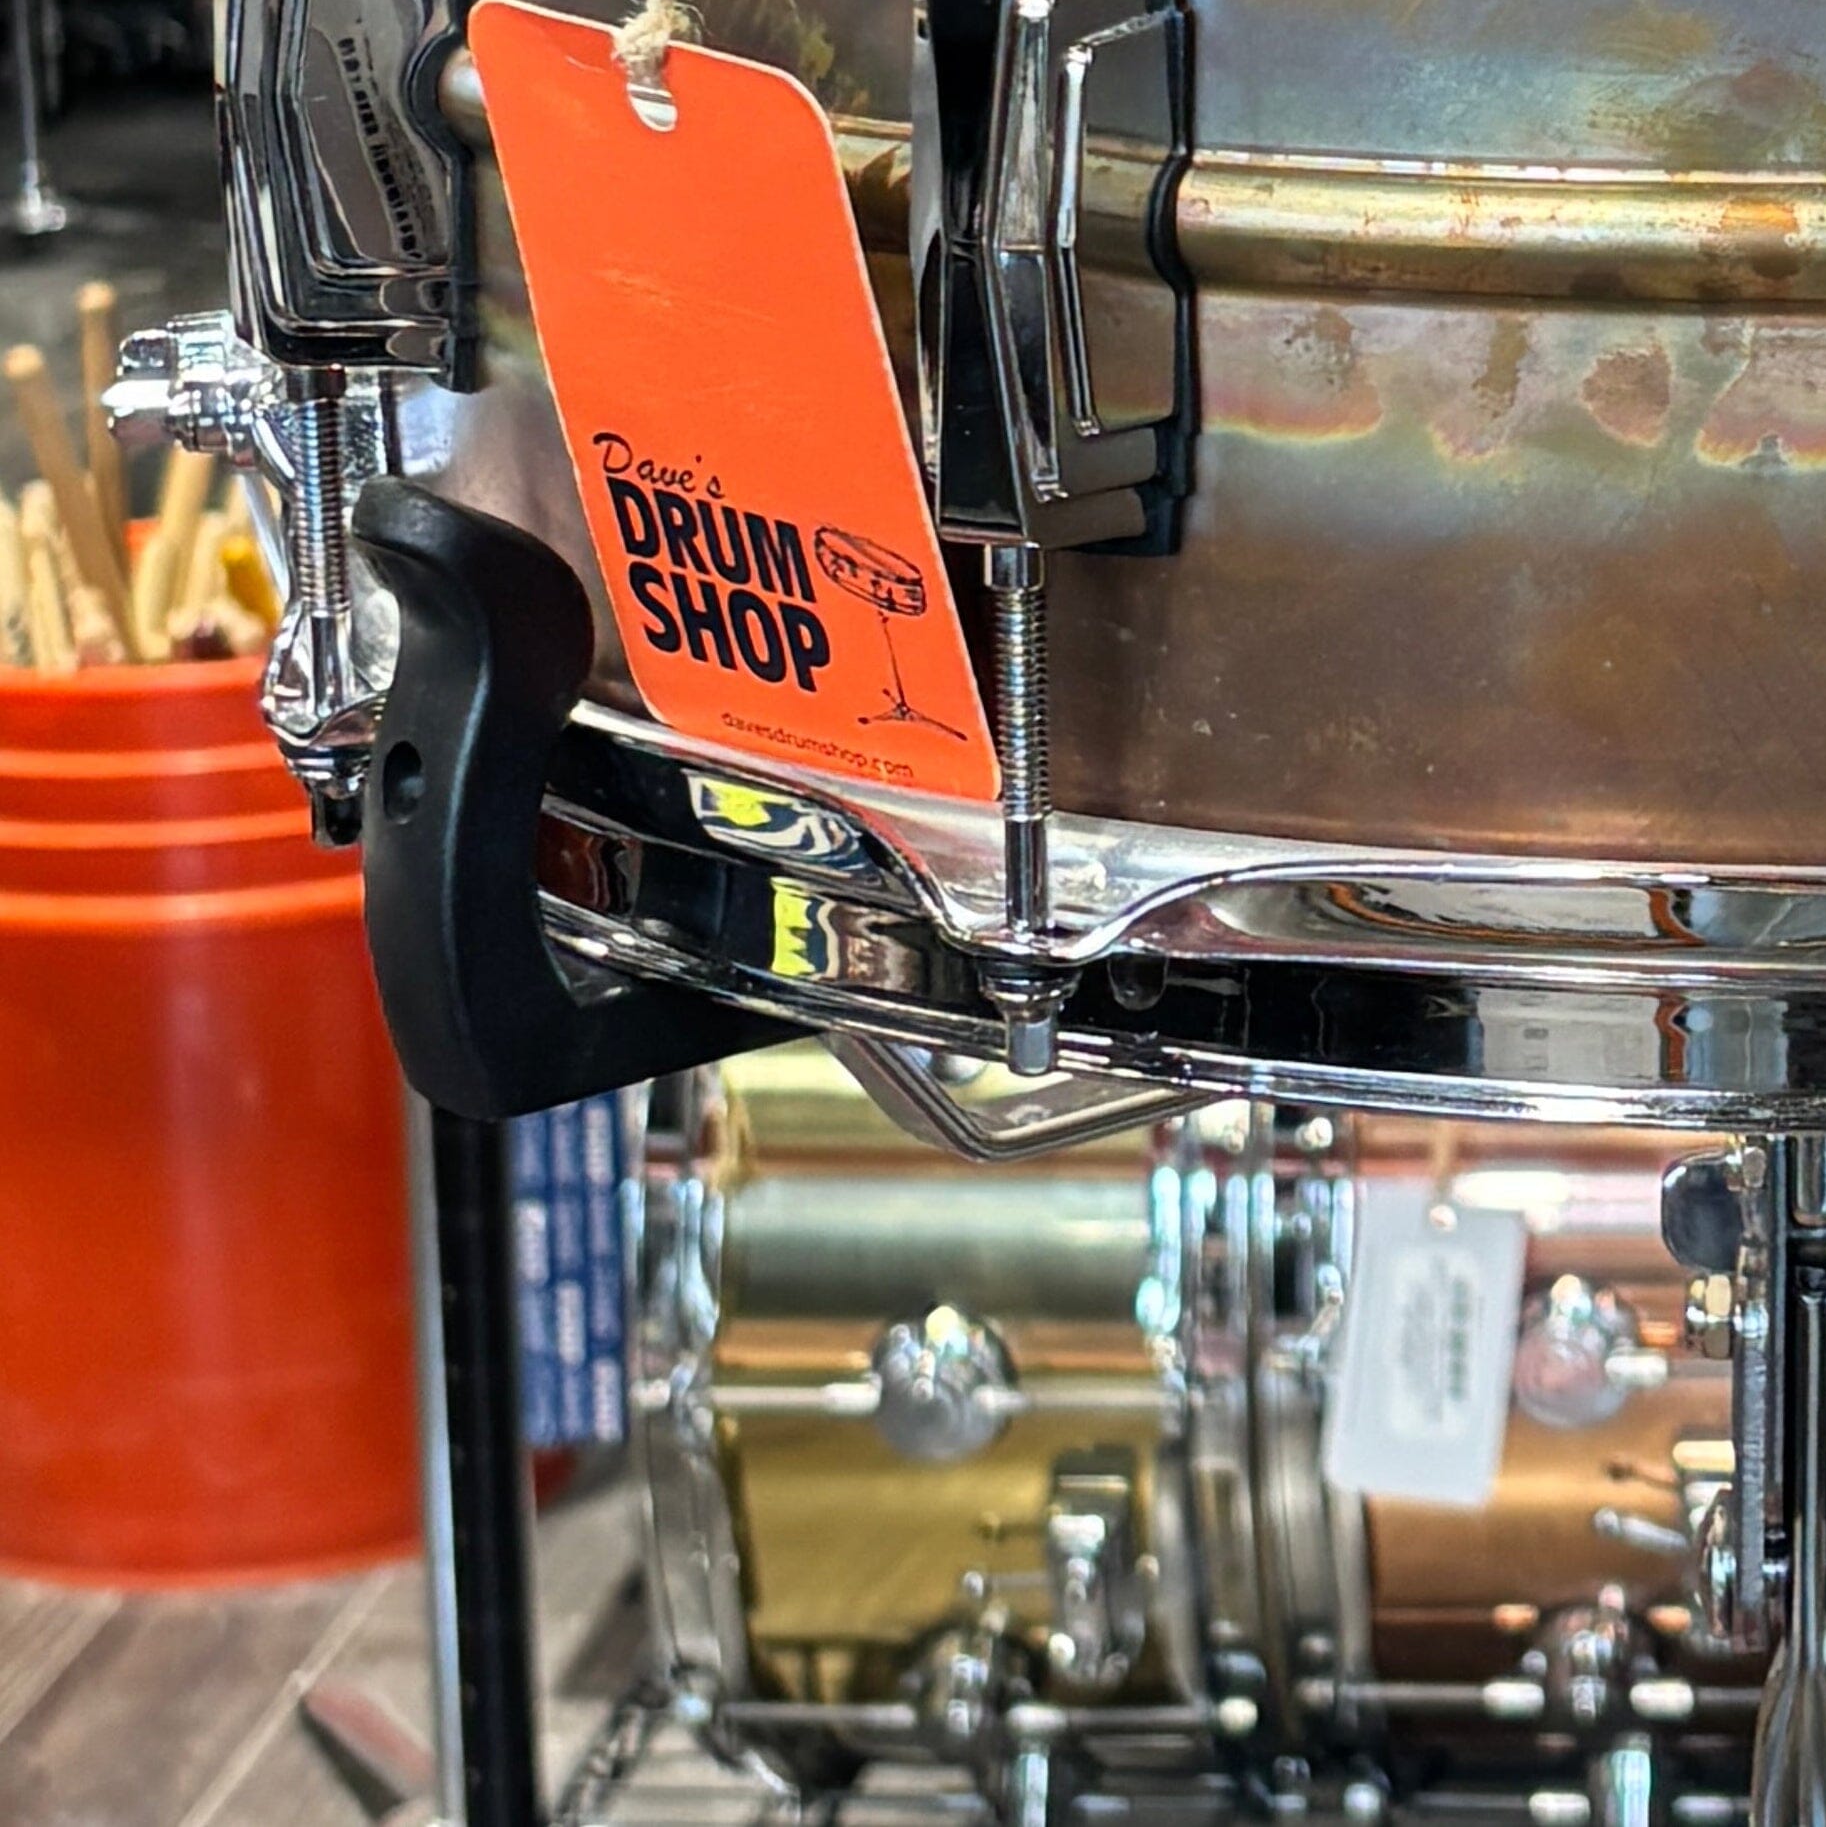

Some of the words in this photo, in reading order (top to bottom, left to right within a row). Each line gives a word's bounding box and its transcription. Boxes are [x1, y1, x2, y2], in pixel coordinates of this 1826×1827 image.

[592, 431, 725, 499] Dave's
[606, 476, 816, 604] DRUM
[628, 561, 831, 693] SHOP
